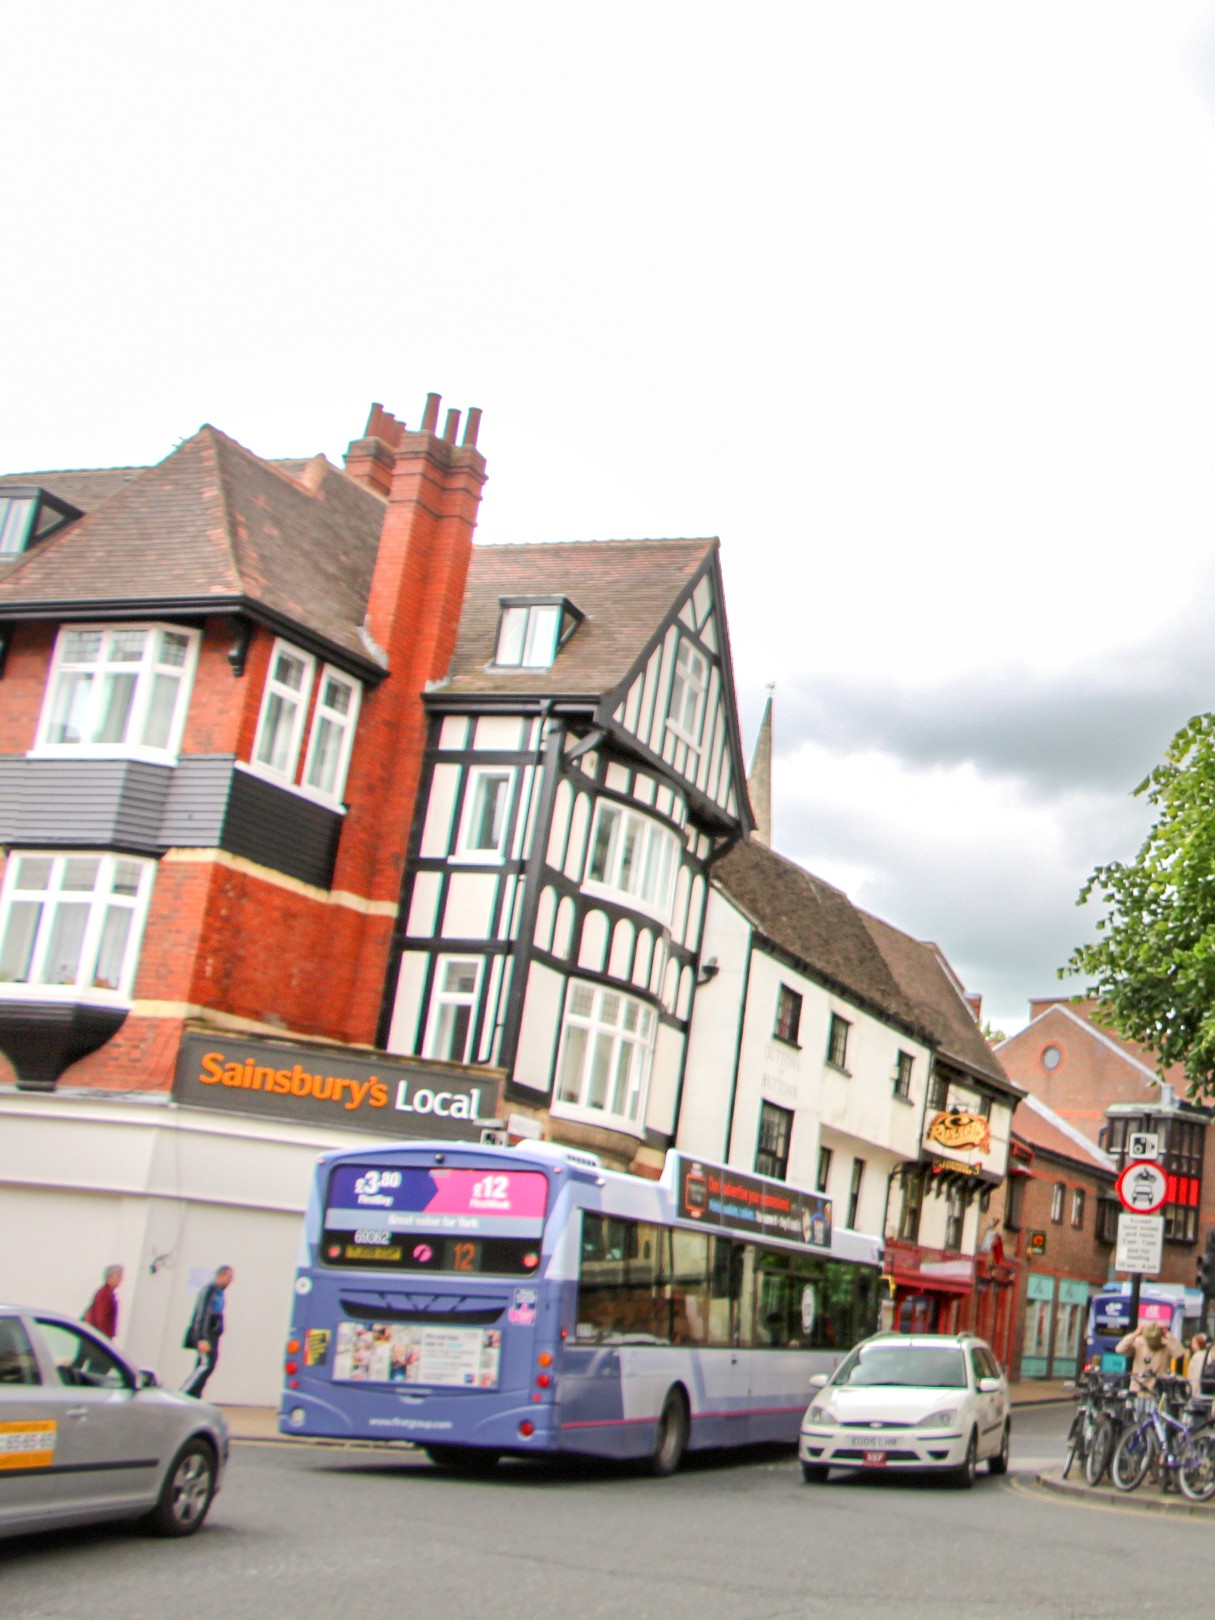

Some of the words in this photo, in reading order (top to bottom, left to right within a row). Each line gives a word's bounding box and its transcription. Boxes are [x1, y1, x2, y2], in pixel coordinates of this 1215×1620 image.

[199, 1052, 389, 1111] Sainsbury's
[395, 1080, 482, 1121] Local
[354, 1170, 403, 1194] £3.80
[472, 1175, 510, 1198] £12
[454, 1242, 476, 1271] 12
